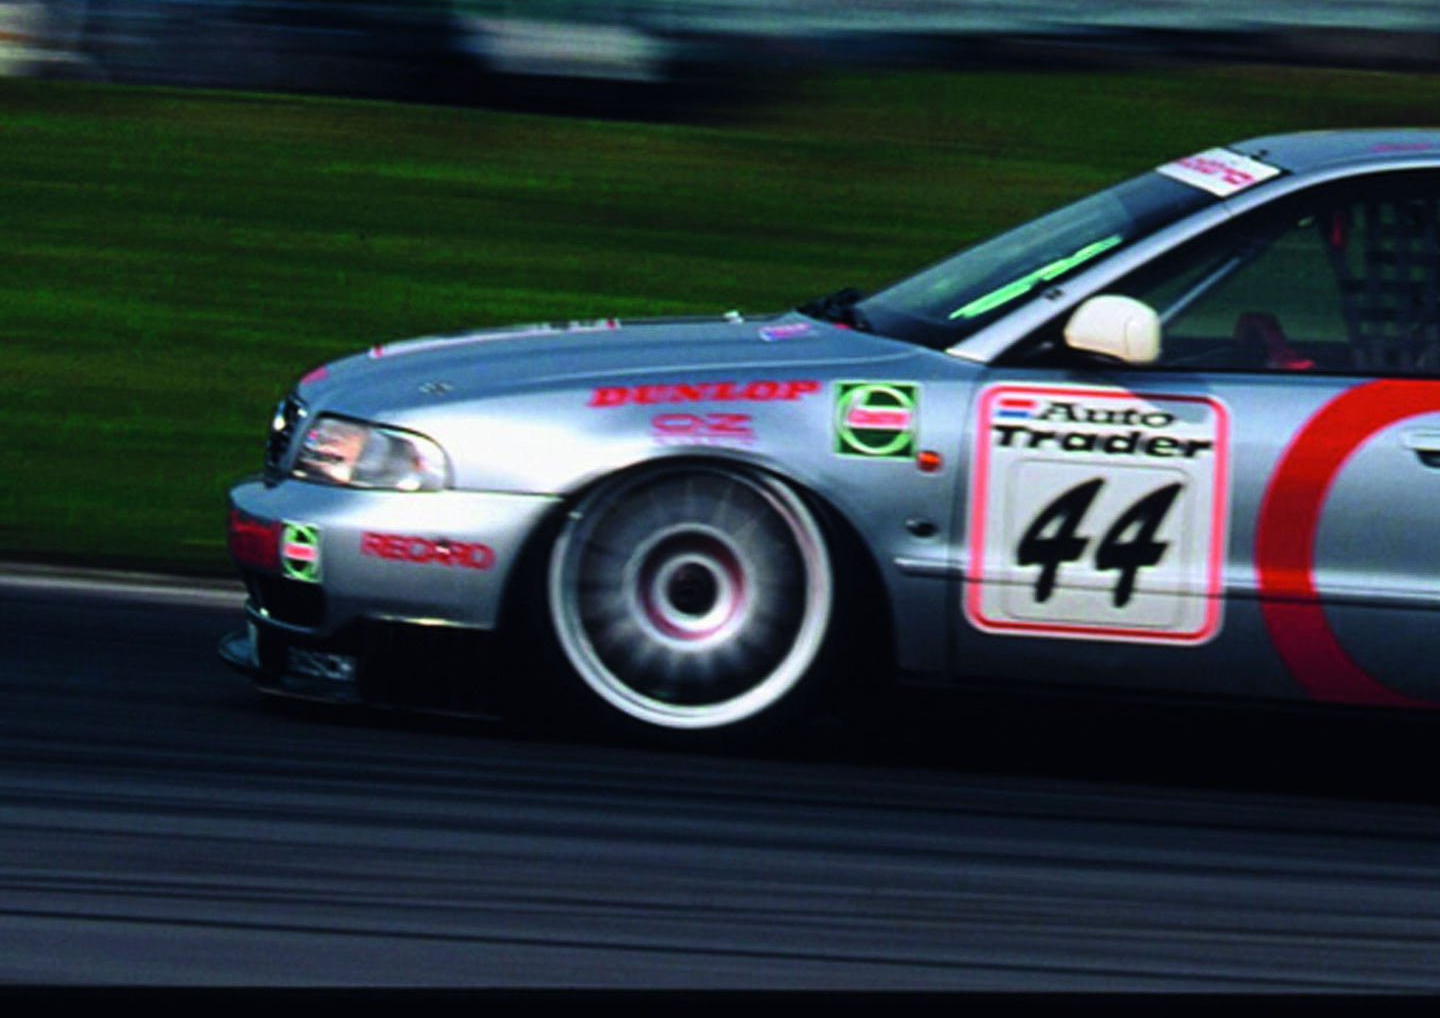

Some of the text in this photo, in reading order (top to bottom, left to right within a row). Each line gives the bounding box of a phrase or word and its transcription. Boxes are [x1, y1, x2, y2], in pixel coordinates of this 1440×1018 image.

[587, 380, 821, 408] DUNLOP
[1036, 402, 1176, 428] Auto
[990, 424, 1215, 458] Trader
[1016, 476, 1184, 609] 44
